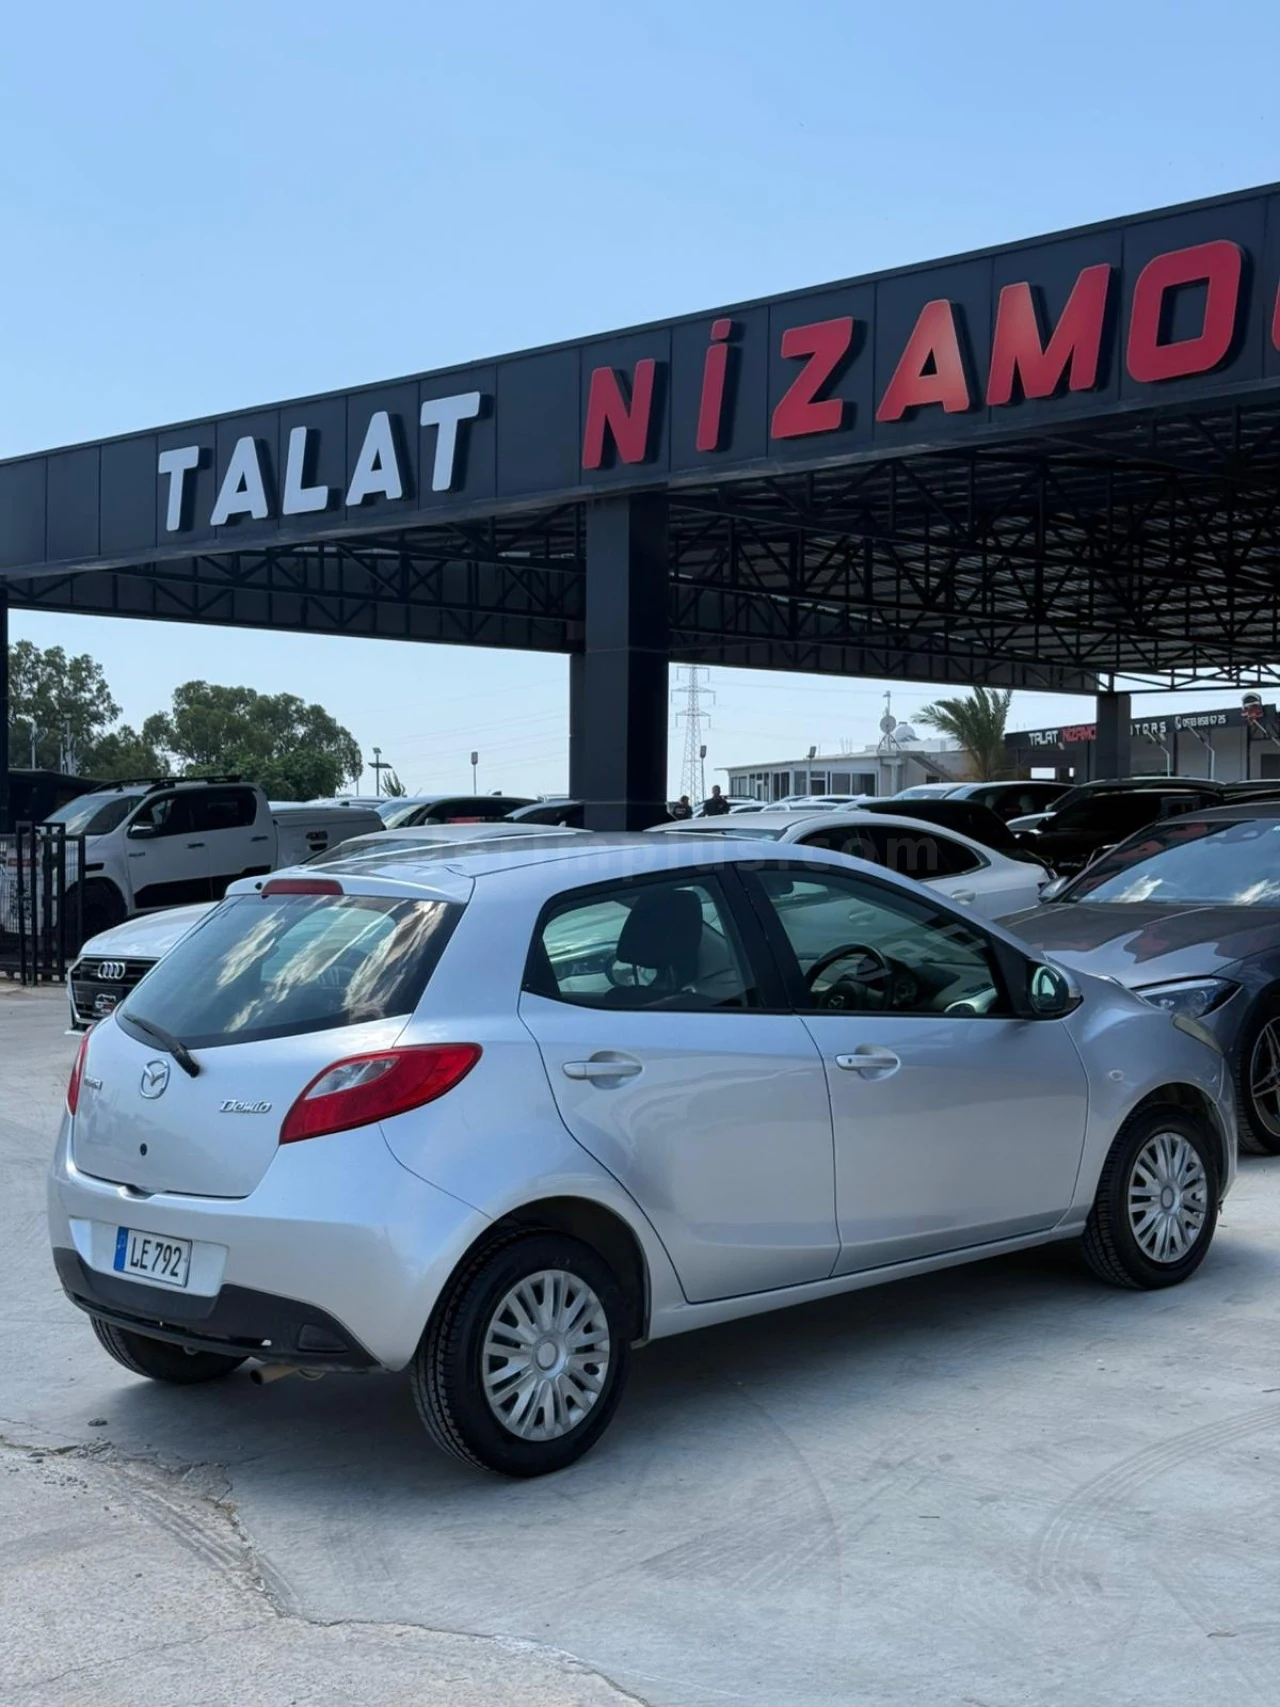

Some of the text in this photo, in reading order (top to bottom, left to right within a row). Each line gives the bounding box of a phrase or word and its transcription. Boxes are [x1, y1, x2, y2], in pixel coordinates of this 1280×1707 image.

[157, 238, 1280, 532] TALAT NİZAMO
[1028, 730, 1058, 746] TALAT
